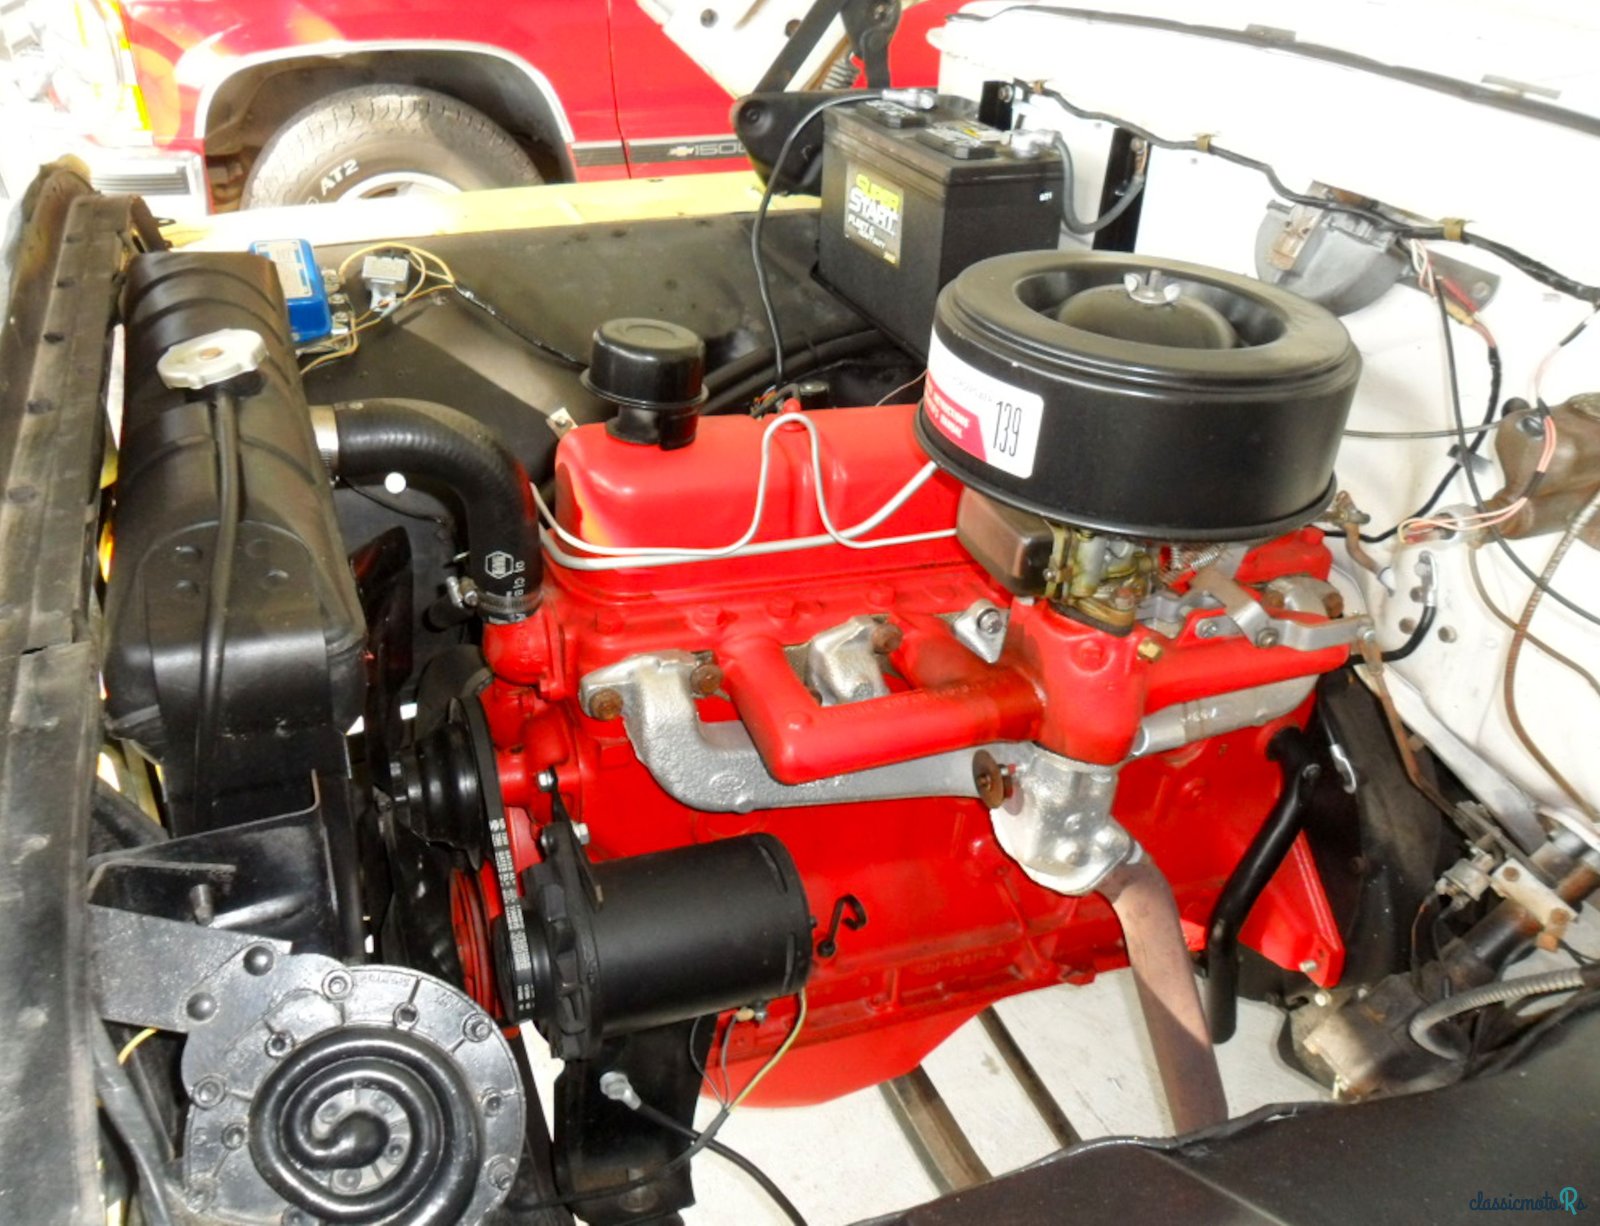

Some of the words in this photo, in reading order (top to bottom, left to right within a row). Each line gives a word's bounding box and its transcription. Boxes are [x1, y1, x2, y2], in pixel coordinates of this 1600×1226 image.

[321, 159, 359, 196] AT2
[848, 187, 900, 236] START
[993, 401, 1022, 457] 139
